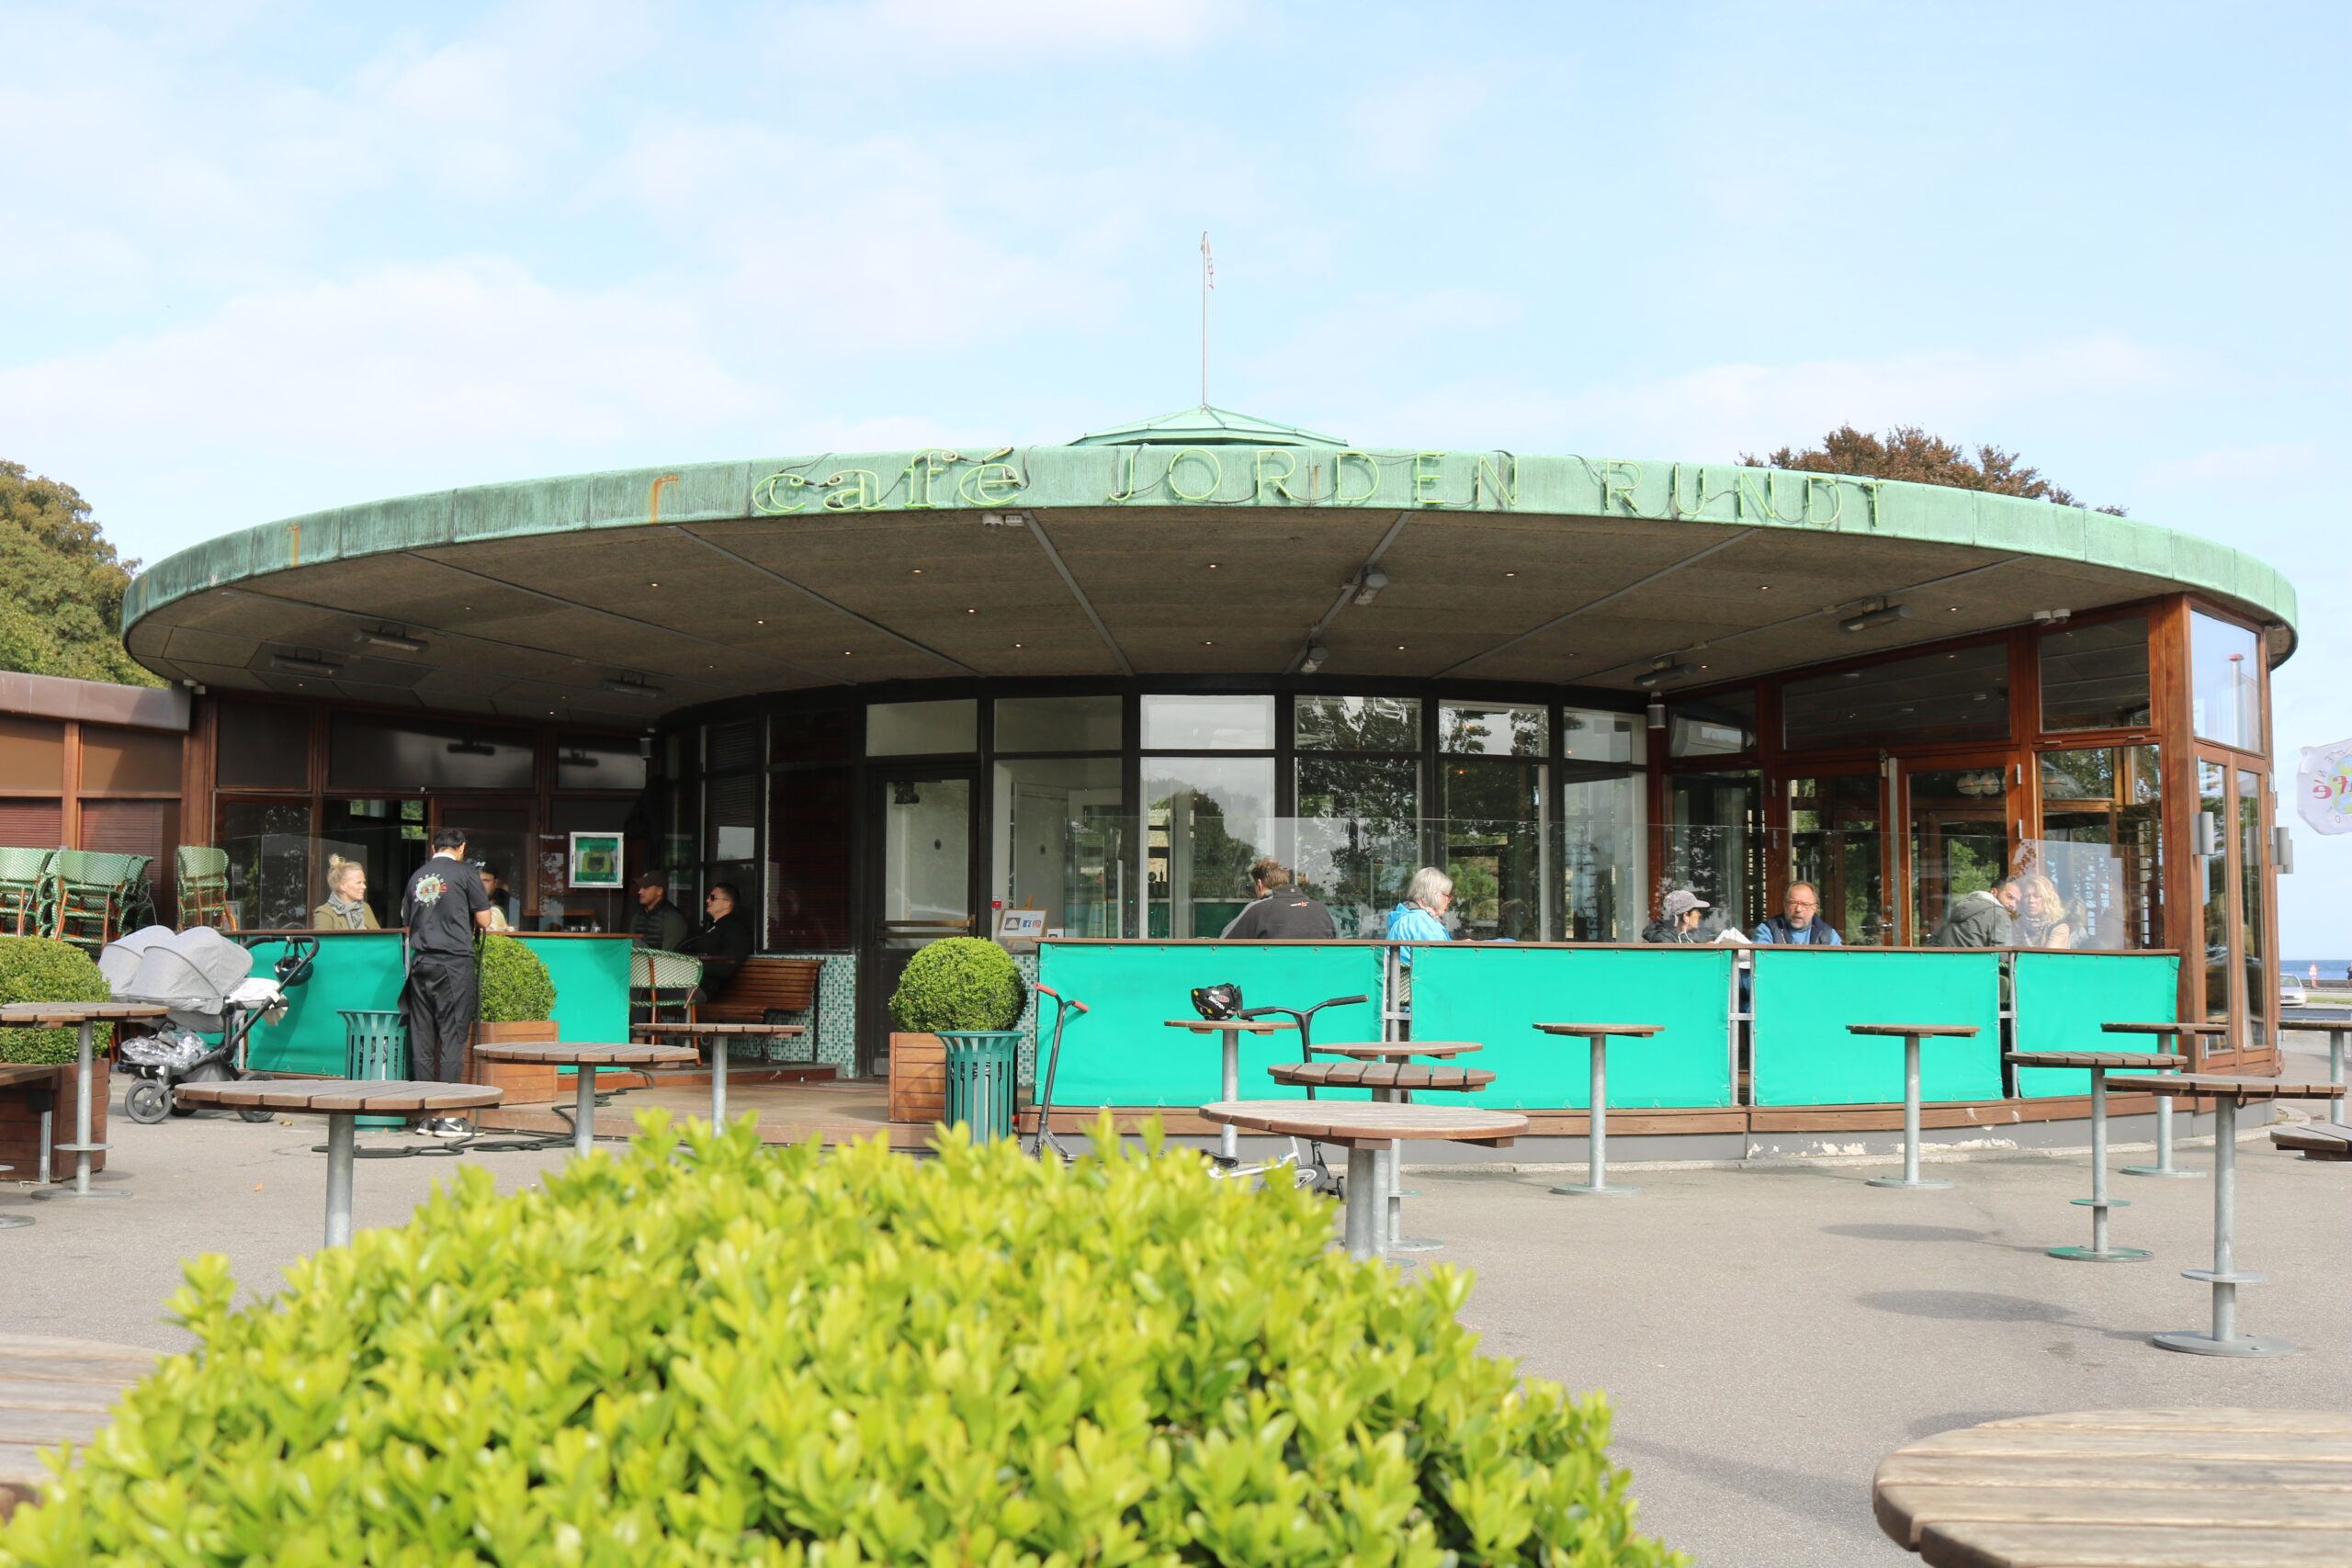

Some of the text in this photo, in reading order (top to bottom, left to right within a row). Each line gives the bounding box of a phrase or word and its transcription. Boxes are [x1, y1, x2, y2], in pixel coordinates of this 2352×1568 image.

[752, 446, 1886, 528] café JORDEN RUNDT
